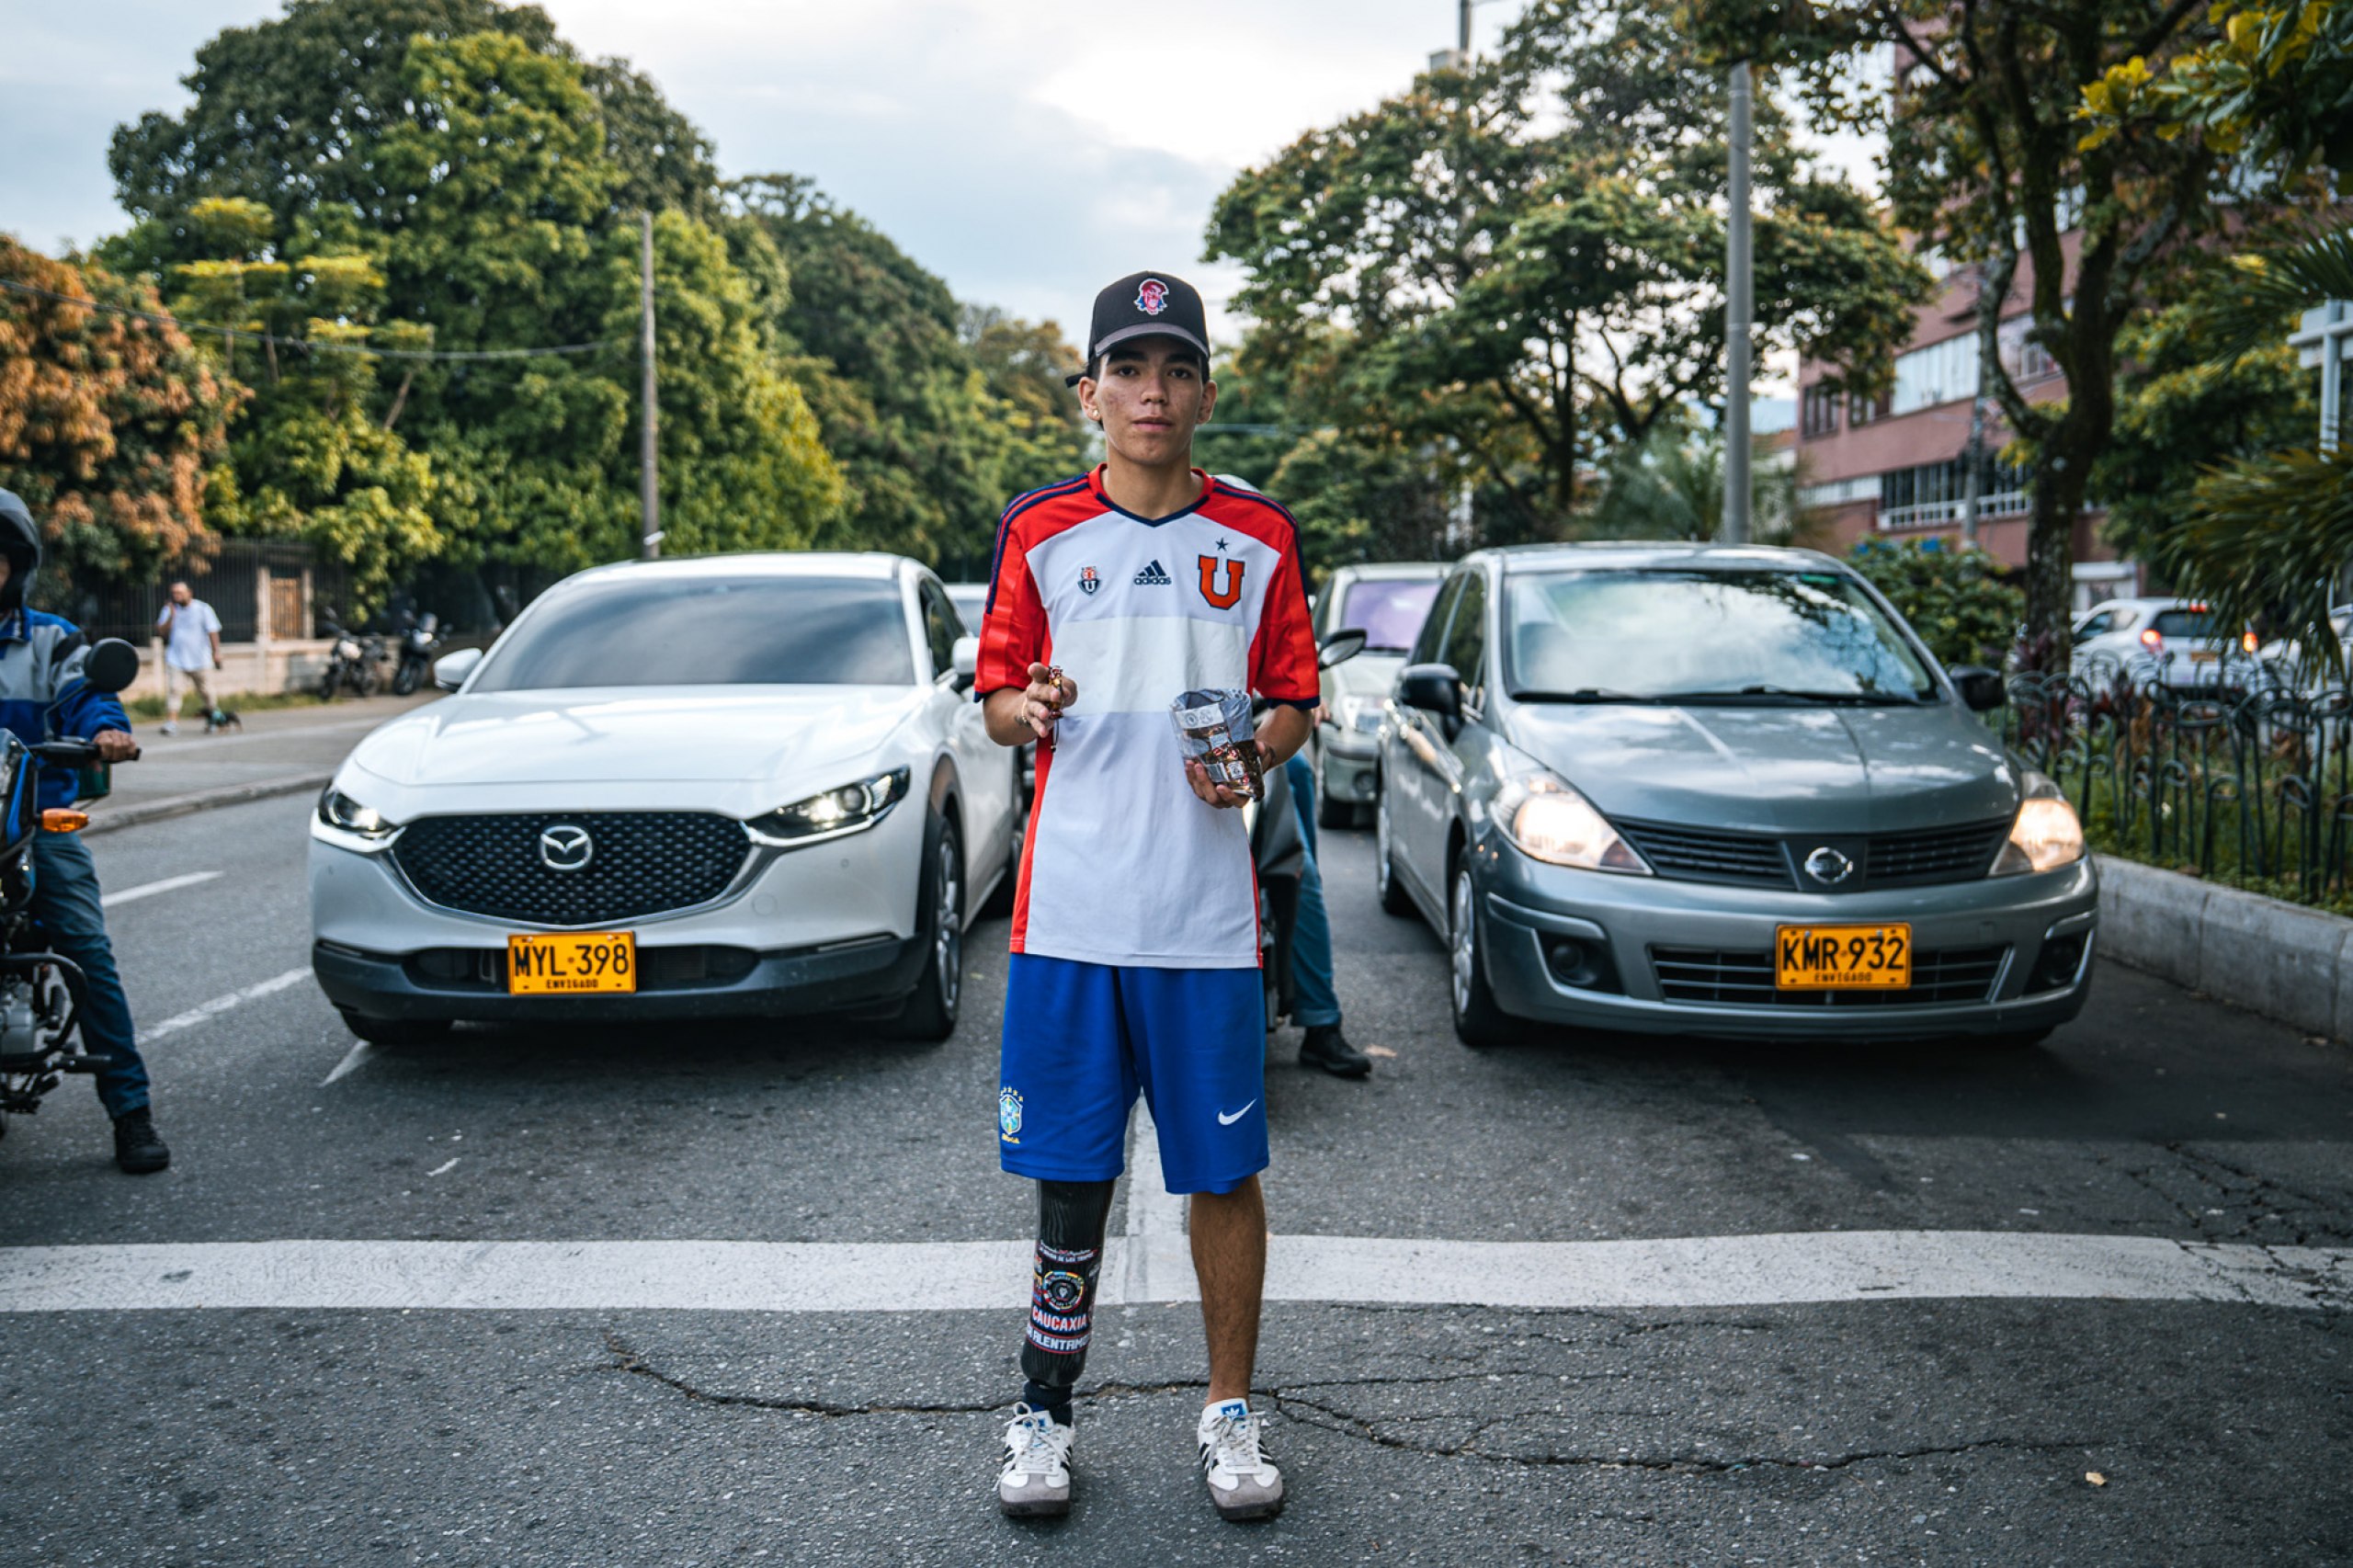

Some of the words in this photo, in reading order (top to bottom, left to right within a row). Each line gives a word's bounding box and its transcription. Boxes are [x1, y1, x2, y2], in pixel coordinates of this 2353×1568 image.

[1133, 576, 1172, 585] adidas
[1198, 554, 1245, 610] U
[514, 945, 567, 977] MYL
[574, 943, 630, 975] 398
[1782, 937, 1839, 971] KMR
[1847, 936, 1904, 971] 932
[546, 979, 598, 990] ENVIGADO
[1814, 971, 1872, 982] ENVIGADO
[1032, 1305, 1087, 1332] CAUCAXIA
